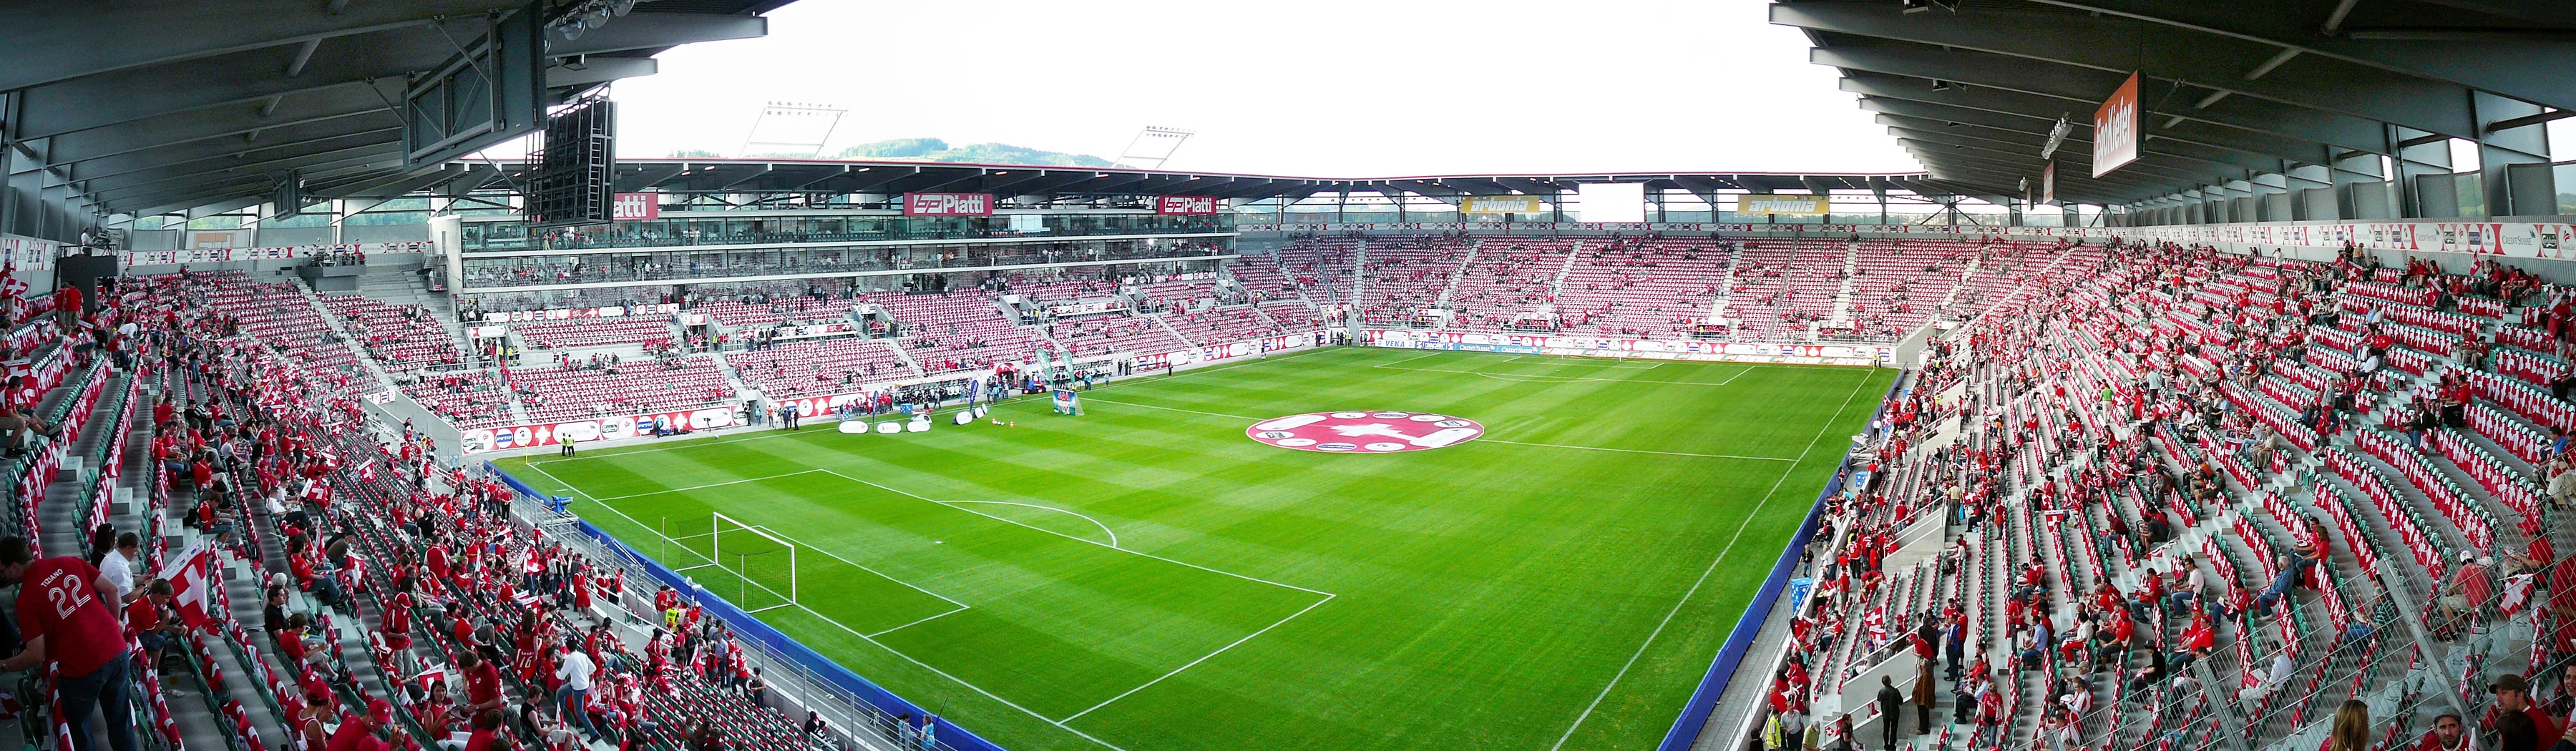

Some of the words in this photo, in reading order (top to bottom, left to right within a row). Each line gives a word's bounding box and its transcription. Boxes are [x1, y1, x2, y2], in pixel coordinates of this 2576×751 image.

[2096, 95, 2133, 167] EgoKiefer
[613, 195, 647, 217] atti
[943, 195, 984, 214] Piatti
[1184, 197, 1212, 213] Piatti
[1470, 197, 1529, 212] arbonia
[1748, 196, 1818, 212] arbonia
[2502, 235, 2517, 245] CREDIT
[2517, 235, 2532, 245] SUISSE
[41, 569, 64, 587] TIZIANO
[48, 574, 92, 620] 22
[519, 656, 534, 668] 16
